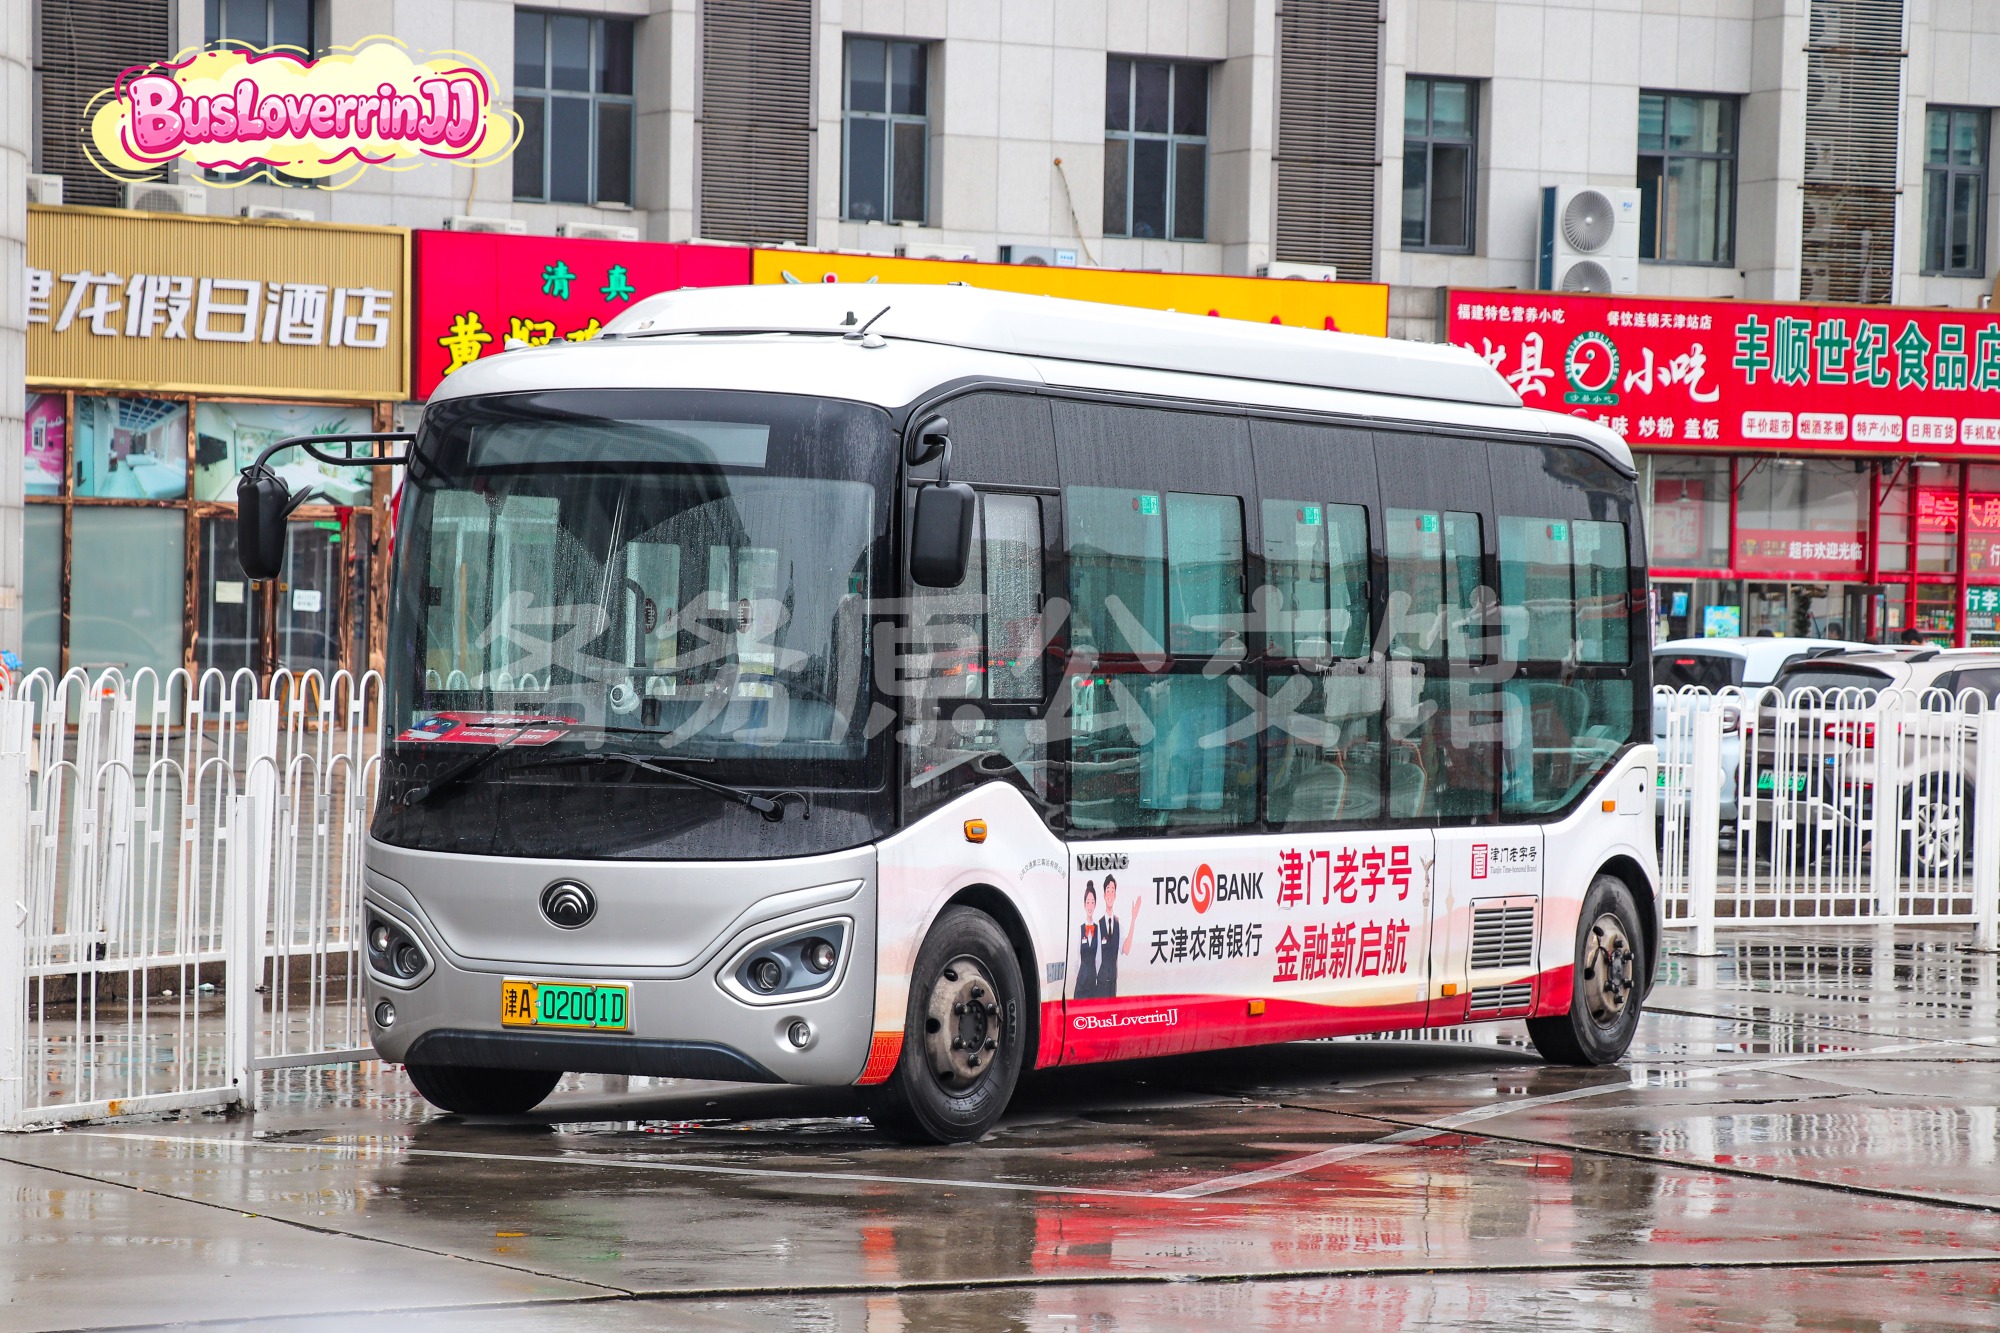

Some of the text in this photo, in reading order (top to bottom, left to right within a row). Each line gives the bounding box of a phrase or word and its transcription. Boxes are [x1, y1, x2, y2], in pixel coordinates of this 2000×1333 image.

[541, 260, 635, 302] 清真
[1457, 303, 1713, 331] 福建特色营养小吃 餐饮连锁天津站店
[1732, 314, 2000, 392] 丰顺世纪食品店
[1623, 342, 1720, 403] 小吃
[1638, 415, 1675, 438] 炒粉
[1683, 417, 1720, 440] 盖饭
[1746, 417, 2000, 441] 平价超市 烟酒茶糖 特产小吃 日用百货 手机配
[1789, 541, 1863, 560] 超市欢迎光临
[1077, 853, 1129, 871] YUTONG
[1490, 846, 1537, 863] 津门老字号
[1152, 872, 1264, 905] TRC BANK
[1276, 845, 1412, 907] 津门老字号
[1150, 922, 1263, 965] 天津农商银行
[1273, 917, 1411, 983] 金融新启航
